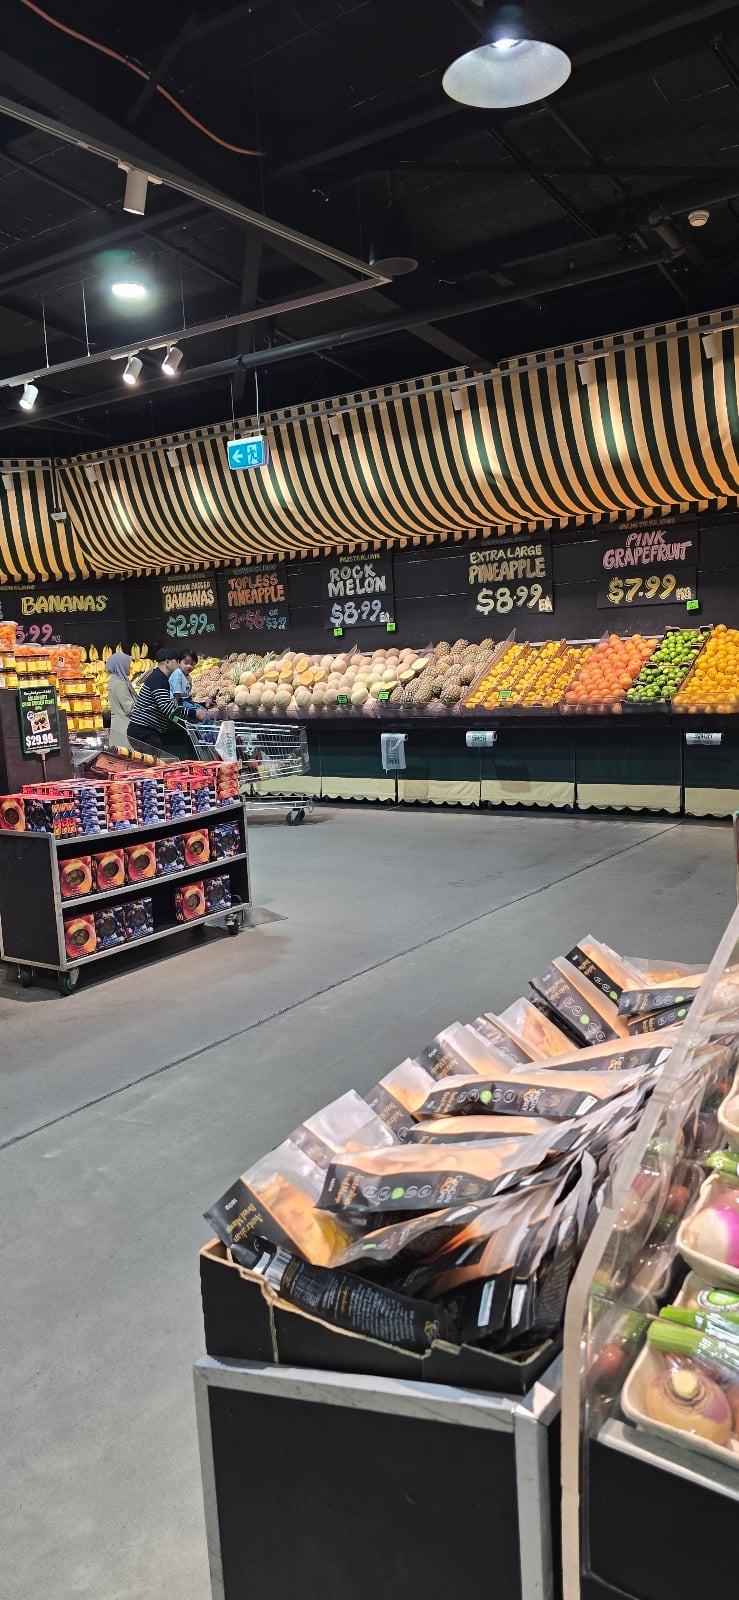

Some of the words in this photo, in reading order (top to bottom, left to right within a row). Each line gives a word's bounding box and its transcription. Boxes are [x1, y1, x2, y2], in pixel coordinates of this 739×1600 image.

[626, 530, 667, 548] PINK
[469, 550, 506, 564] EXTRA
[507, 544, 543, 558] LARGE
[603, 541, 692, 569] GRAPEFRUIT
[330, 564, 376, 582] ROCK
[469, 557, 546, 584] PINEAPPLE
[228, 573, 278, 590] TOPLESS
[328, 576, 386, 597] MELON
[607, 574, 676, 604] $7.99
[21, 595, 109, 615] BANANAS
[165, 589, 215, 610] BANANAS
[228, 585, 285, 606] PINEAPPLE
[476, 584, 542, 615] $8.99
[229, 612, 241, 630] 2
[245, 609, 266, 630] $6
[330, 600, 382, 628] $8.99
[167, 613, 208, 638] $2.99
[26, 733, 54, 747] $29.99
[240, 1203, 257, 1220] Dried
[226, 1215, 245, 1234] Mango
[234, 1213, 264, 1242] Australian
